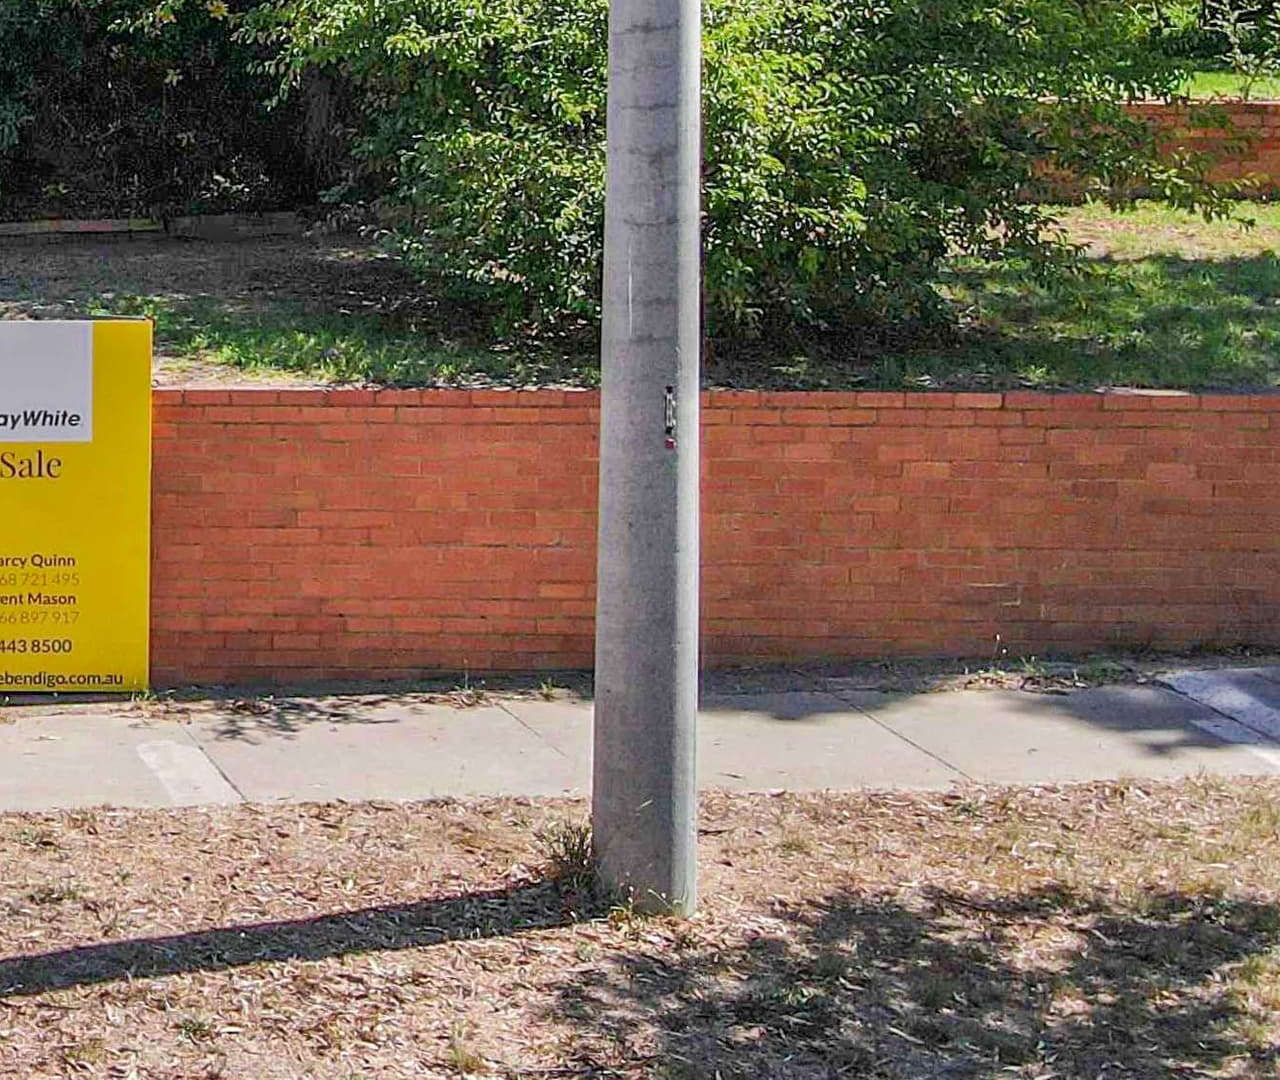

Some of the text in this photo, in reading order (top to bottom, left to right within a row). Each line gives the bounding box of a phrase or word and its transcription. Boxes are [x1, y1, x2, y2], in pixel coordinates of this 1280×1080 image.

[0, 449, 62, 478] Sale
[31, 554, 75, 568] Quinn
[21, 574, 47, 586] 721
[51, 573, 80, 585] 495
[27, 592, 76, 605] Mason
[20, 611, 48, 624] 897
[51, 611, 80, 624] 917
[31, 639, 72, 653] 8500
